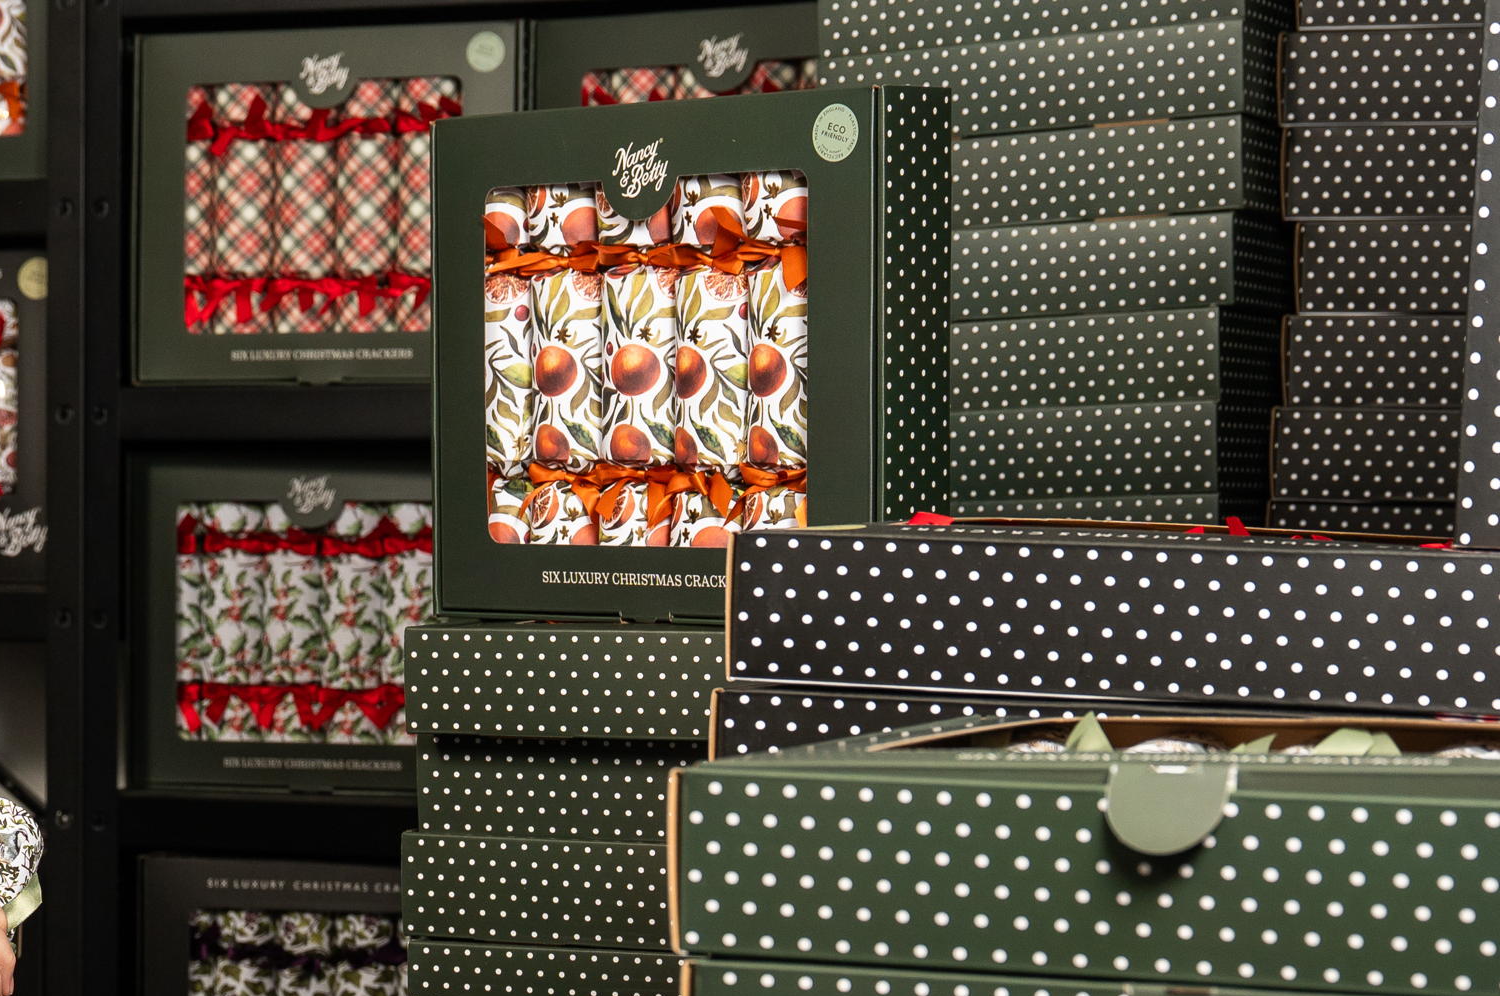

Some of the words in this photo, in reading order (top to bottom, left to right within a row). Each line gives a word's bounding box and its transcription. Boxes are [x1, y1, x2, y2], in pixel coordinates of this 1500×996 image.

[827, 122, 846, 134] ECO
[821, 130, 849, 143] FRIENDLY
[612, 140, 659, 176] Nancy
[621, 159, 669, 198] Betty
[542, 571, 561, 584] SIX
[563, 571, 610, 585] LUXURY
[612, 572, 681, 587] CHRISTMAS
[684, 574, 726, 588] CRACK
[206, 878, 228, 889] SIX
[233, 879, 285, 890] LUXURY
[292, 880, 368, 892] CHRISTMAS
